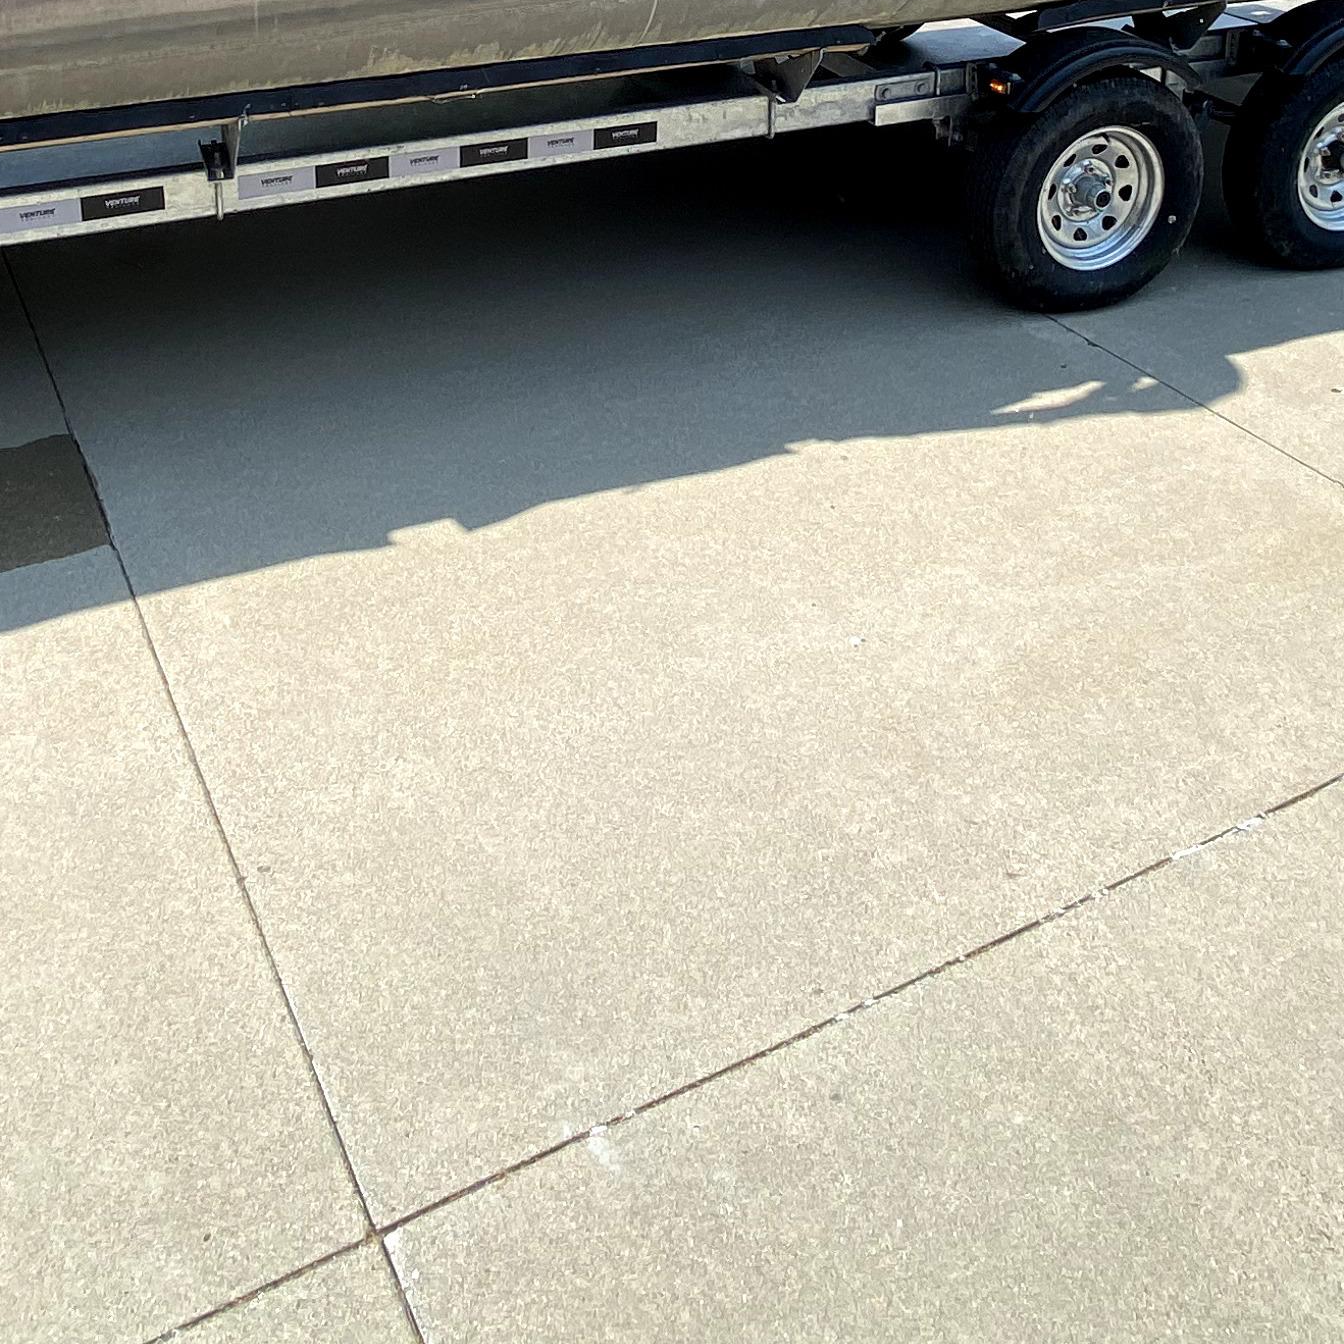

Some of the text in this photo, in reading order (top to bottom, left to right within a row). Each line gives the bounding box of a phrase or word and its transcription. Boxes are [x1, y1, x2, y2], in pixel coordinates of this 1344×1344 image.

[260, 175, 293, 185] VENTURE
[105, 195, 140, 207] VENTURE
[19, 208, 56, 220] VENTURE
